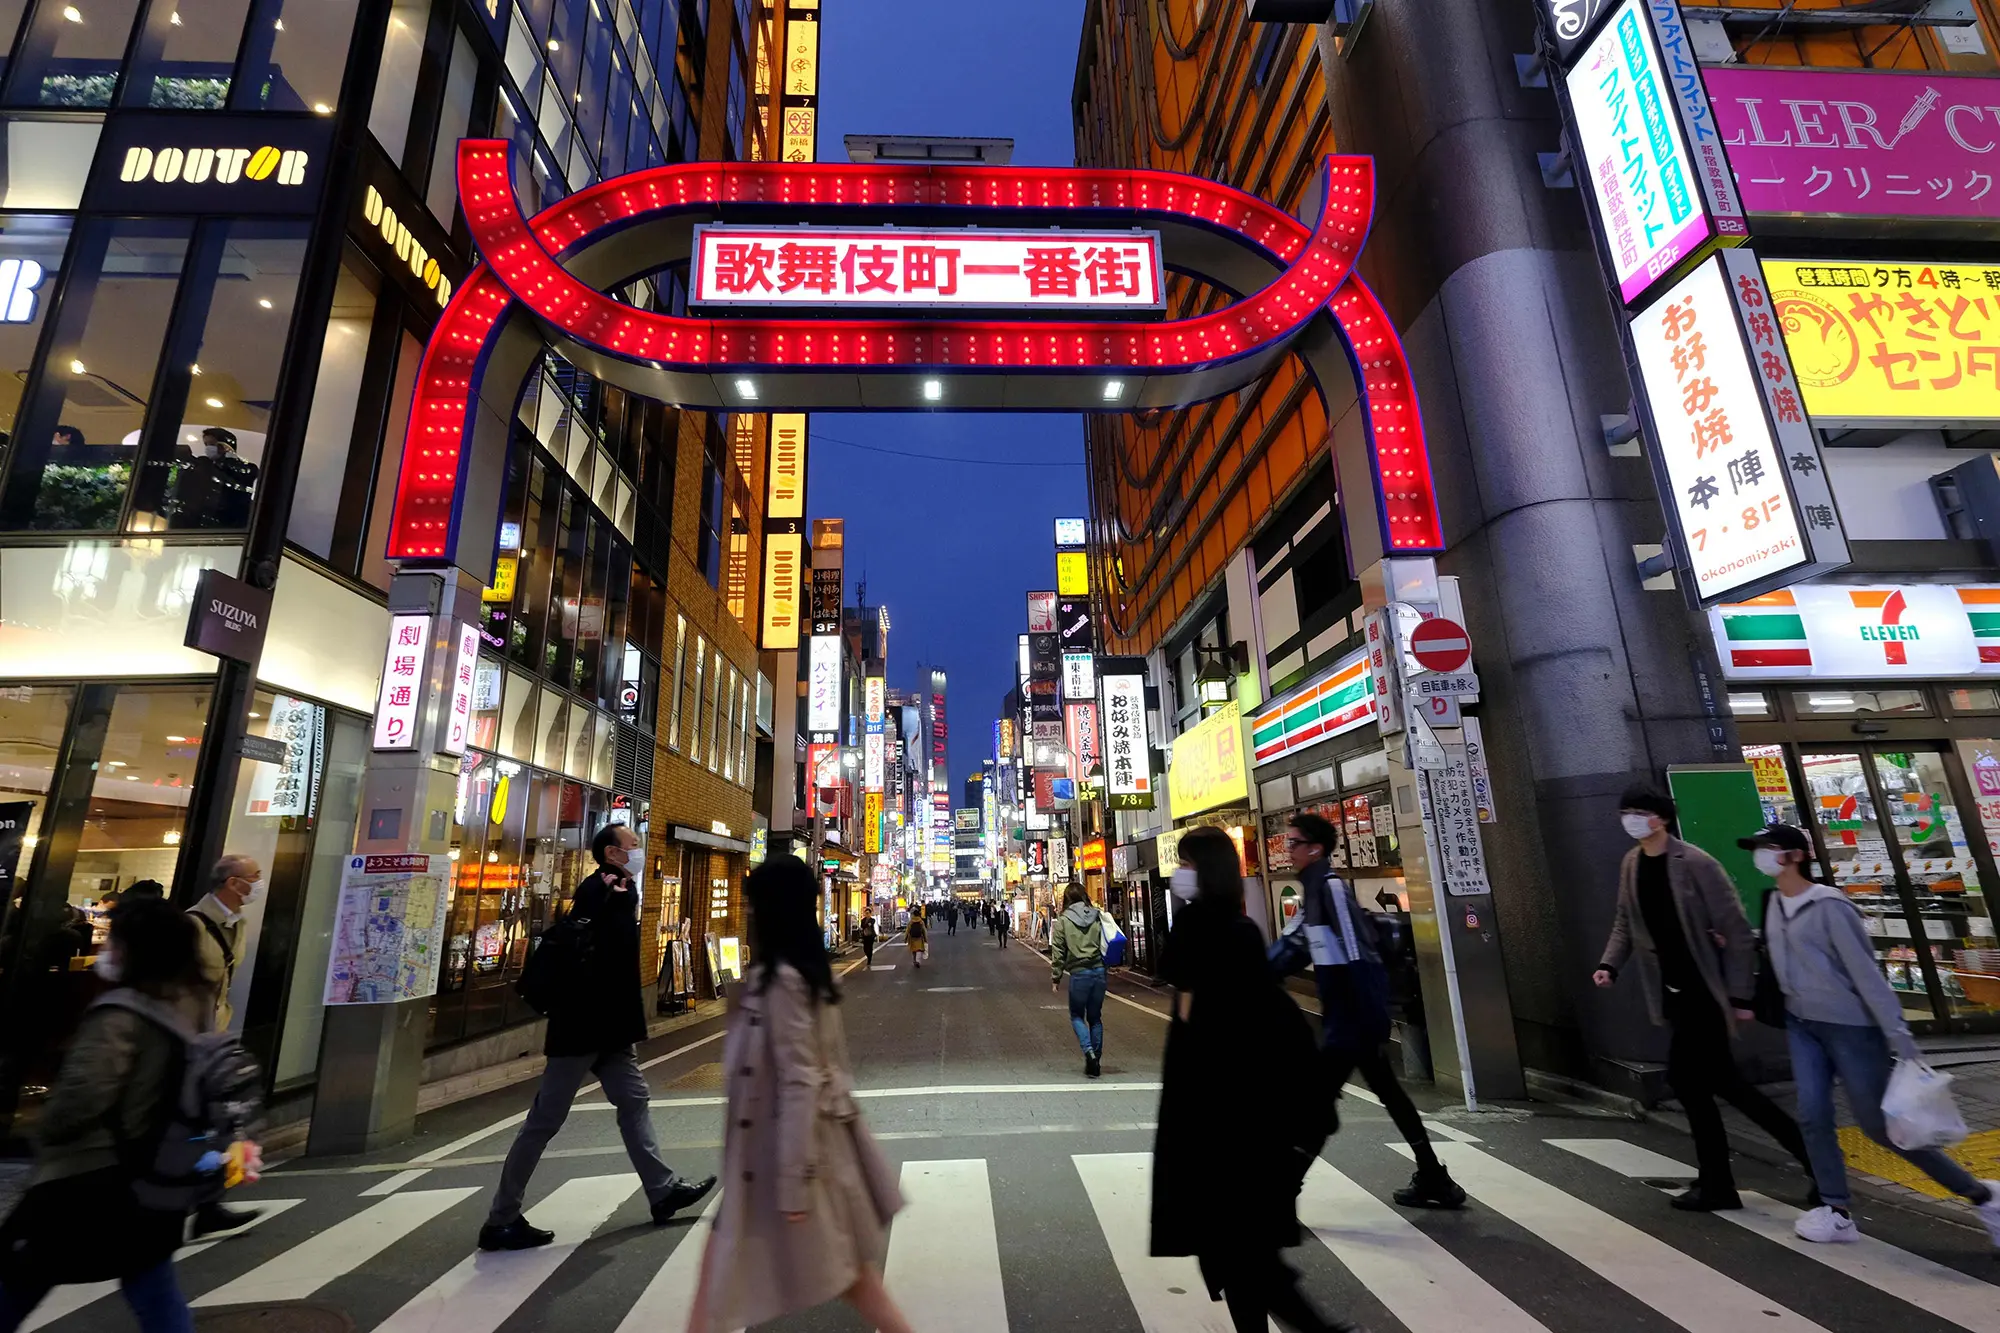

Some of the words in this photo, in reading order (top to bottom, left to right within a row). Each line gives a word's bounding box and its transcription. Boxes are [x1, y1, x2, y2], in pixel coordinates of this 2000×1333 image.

[806, 13, 812, 21] 8
[1621, 14, 1647, 73] ボクシング
[1653, 7, 1713, 141] ファイトフィット
[803, 99, 810, 107] 7
[1639, 81, 1672, 159] キックボクシング
[120, 146, 308, 185] DOUTOR
[1600, 67, 1663, 248] ファイトフィット
[1701, 145, 1731, 212] 新宿歌舞伎町
[1664, 160, 1689, 218] ダイエット
[1732, 166, 1992, 200] ークリニック
[1598, 155, 1638, 269] 新宿歌舞伎町
[1718, 220, 1743, 232] B2F
[364, 185, 452, 309] DOUTOR
[715, 242, 1141, 298] 歌舞伎町一番街
[1647, 248, 1681, 280] B2F
[1798, 268, 1868, 287] 営業時間
[1738, 274, 1802, 423] お好み焼
[1661, 295, 1733, 459] お好み焼
[776, 429, 797, 499] DOUTOR
[1688, 449, 1766, 510] 本陣
[1790, 452, 1836, 531] 本陣
[788, 523, 796, 533] 3
[1701, 535, 1797, 583] okonomiyaki
[772, 551, 793, 627] DOUTOR
[1029, 592, 1054, 600] SHISHA
[1062, 604, 1073, 613] 4F
[210, 599, 257, 629] SUZUYA
[224, 620, 242, 632] BLDG
[816, 623, 837, 632] 3F
[388, 626, 421, 737] 劇場通り
[452, 636, 476, 742] 劇場通り
[1369, 621, 1390, 723] 劇場通り
[1421, 679, 1475, 693] 自転車を除く
[813, 733, 834, 744] 焼肉
[867, 724, 882, 732] B1F
[1035, 724, 1060, 737] 焼肉
[1077, 706, 1092, 778] 焼鳥釜めし
[1111, 694, 1134, 786] お好み焼本陣
[1711, 728, 1722, 737] 17
[1081, 792, 1097, 800] 2F
[1433, 778, 1442, 805] Security
[1443, 797, 1451, 819] Safety
[1437, 807, 1446, 835] Camera
[1446, 766, 1471, 870] 防犯カメラ作動中
[1456, 760, 1482, 874] みなさまの安全を守ります
